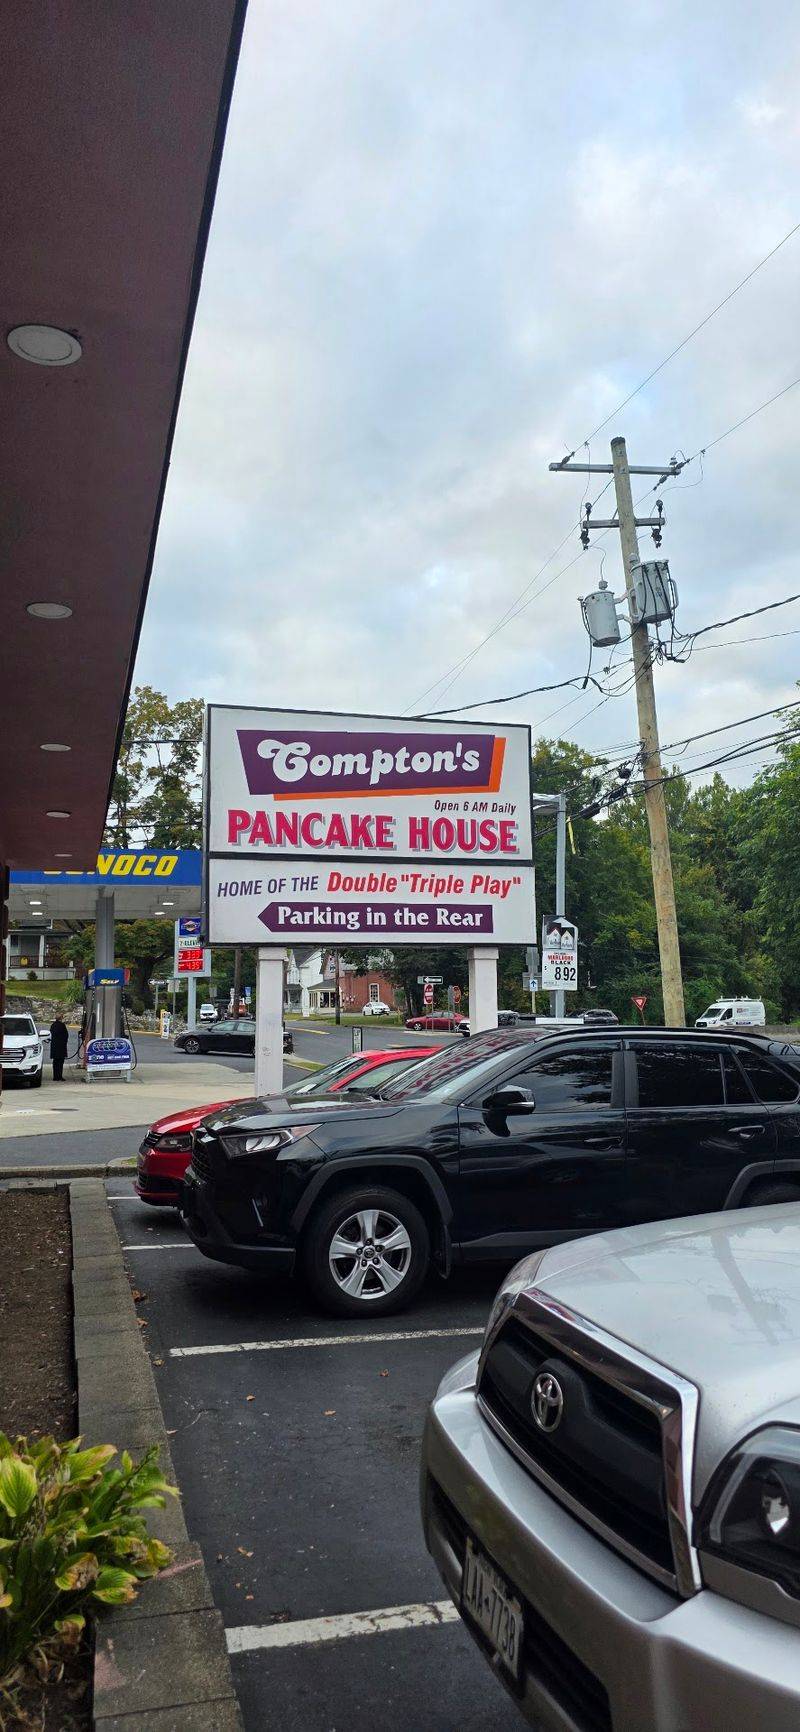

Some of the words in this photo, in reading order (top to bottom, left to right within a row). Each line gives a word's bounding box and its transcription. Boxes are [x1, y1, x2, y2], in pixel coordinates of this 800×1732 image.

[257, 739, 480, 785] Compton's
[434, 800, 459, 812] Open
[463, 801, 469, 811] 6
[472, 802, 488, 812] AM
[491, 803, 517, 815] Daily
[228, 809, 396, 850] PANCAKE
[408, 817, 519, 853] HOUSE
[217, 880, 264, 898] HOME
[267, 878, 287, 894] OF
[291, 876, 319, 892] THE
[327, 872, 398, 893] Double
[401, 873, 464, 898] "Triple
[470, 874, 521, 899] Play"
[277, 906, 360, 930] Parking
[366, 907, 387, 925] in
[393, 907, 429, 925] the
[436, 908, 483, 926] Rear
